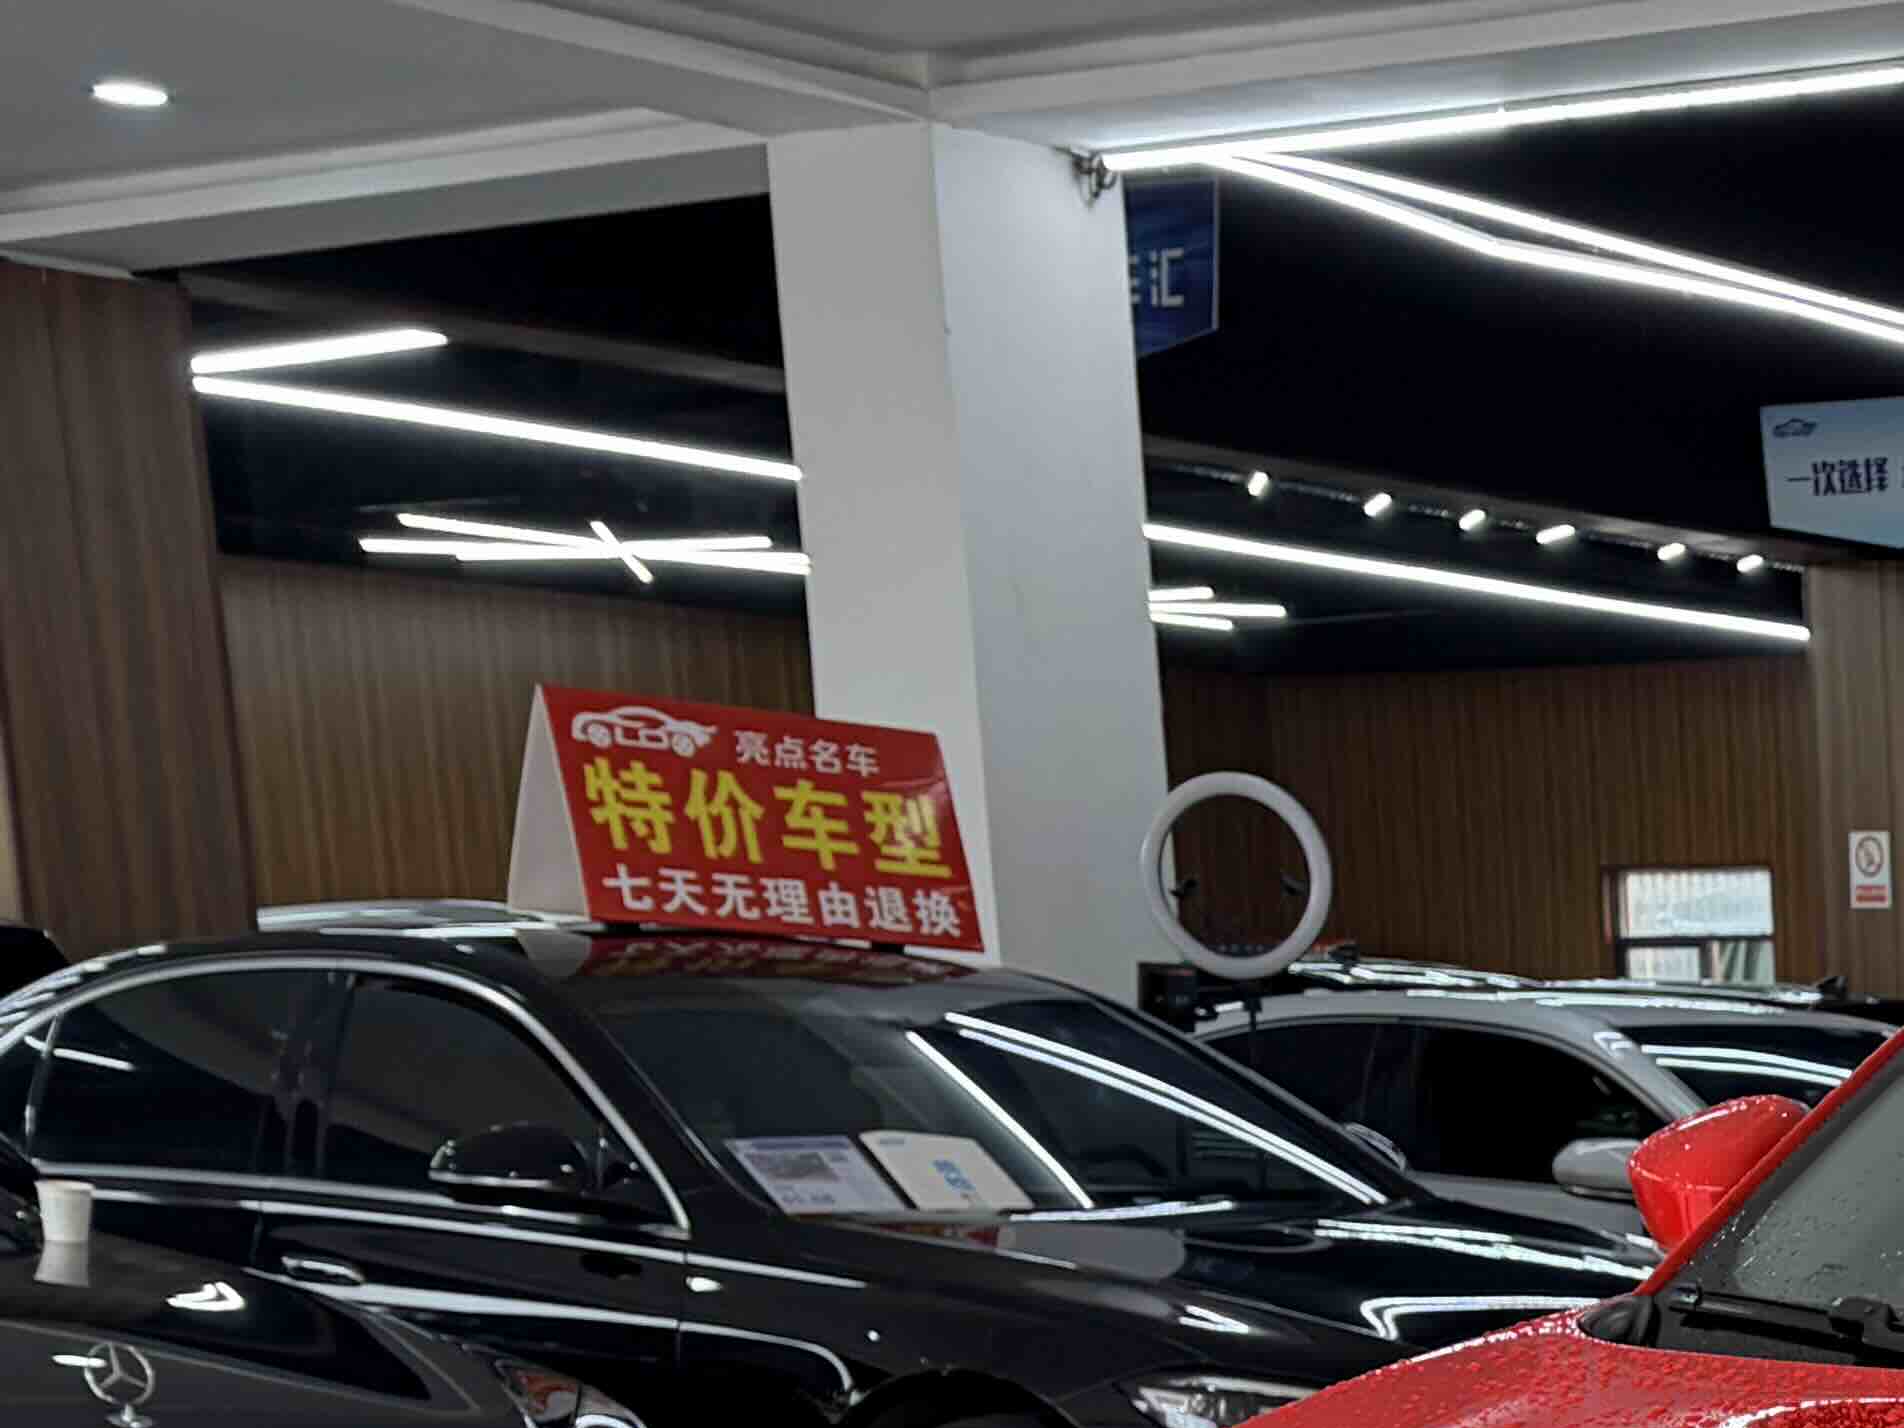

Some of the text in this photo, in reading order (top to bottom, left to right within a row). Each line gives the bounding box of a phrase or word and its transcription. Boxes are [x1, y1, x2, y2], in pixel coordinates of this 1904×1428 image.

[1129, 248, 1186, 307] 汇
[1786, 456, 1889, 497] 一次选择
[735, 728, 881, 778] 亮点名车
[582, 755, 953, 880] 特价车型
[602, 863, 962, 938] 七天无理由退换
